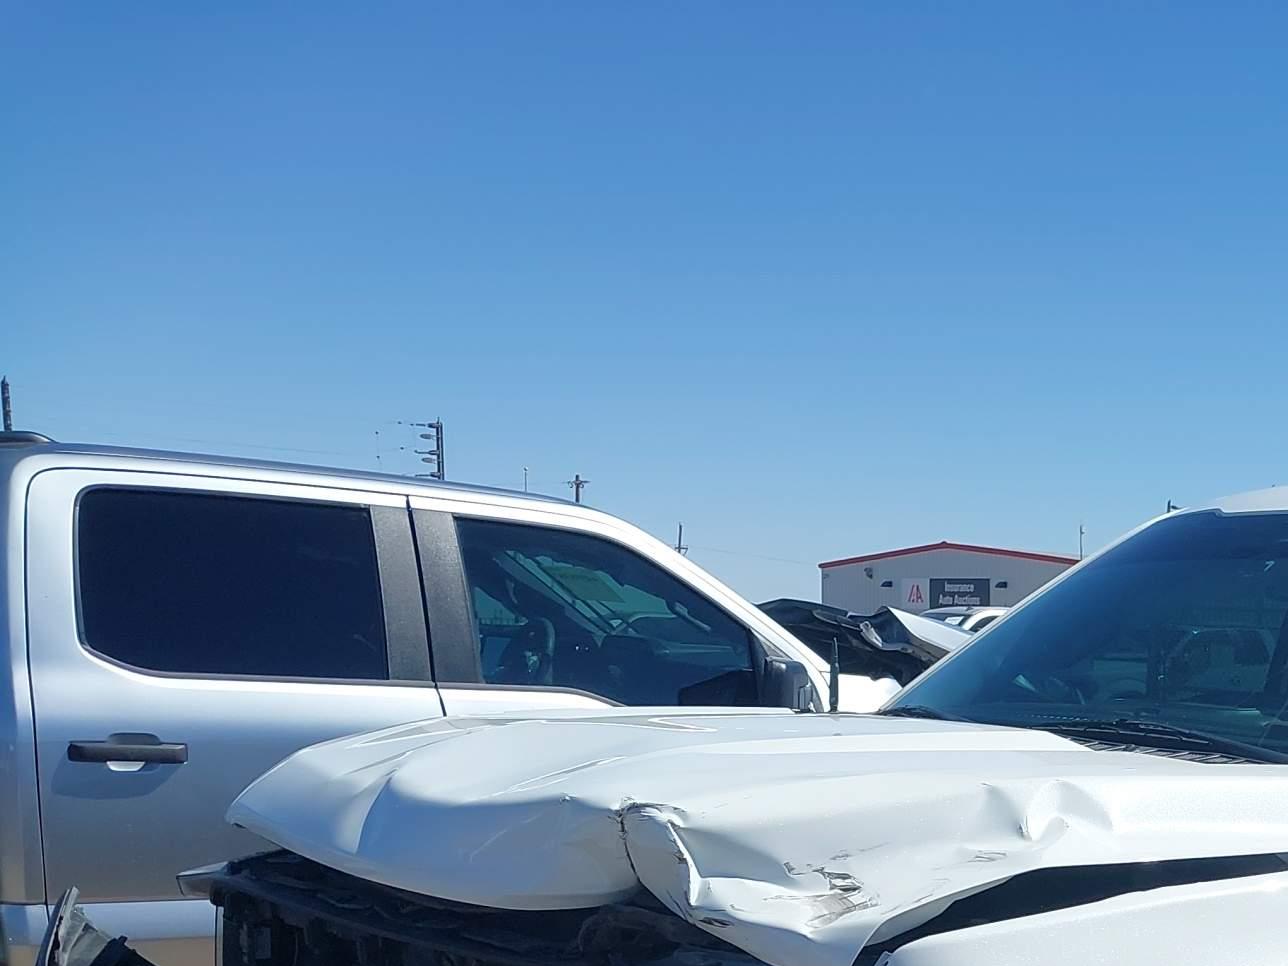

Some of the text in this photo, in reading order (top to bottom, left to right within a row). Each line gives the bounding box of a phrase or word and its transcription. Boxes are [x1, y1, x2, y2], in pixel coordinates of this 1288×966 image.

[944, 580, 975, 593] Insurance
[938, 593, 980, 605] Auto Auctions
